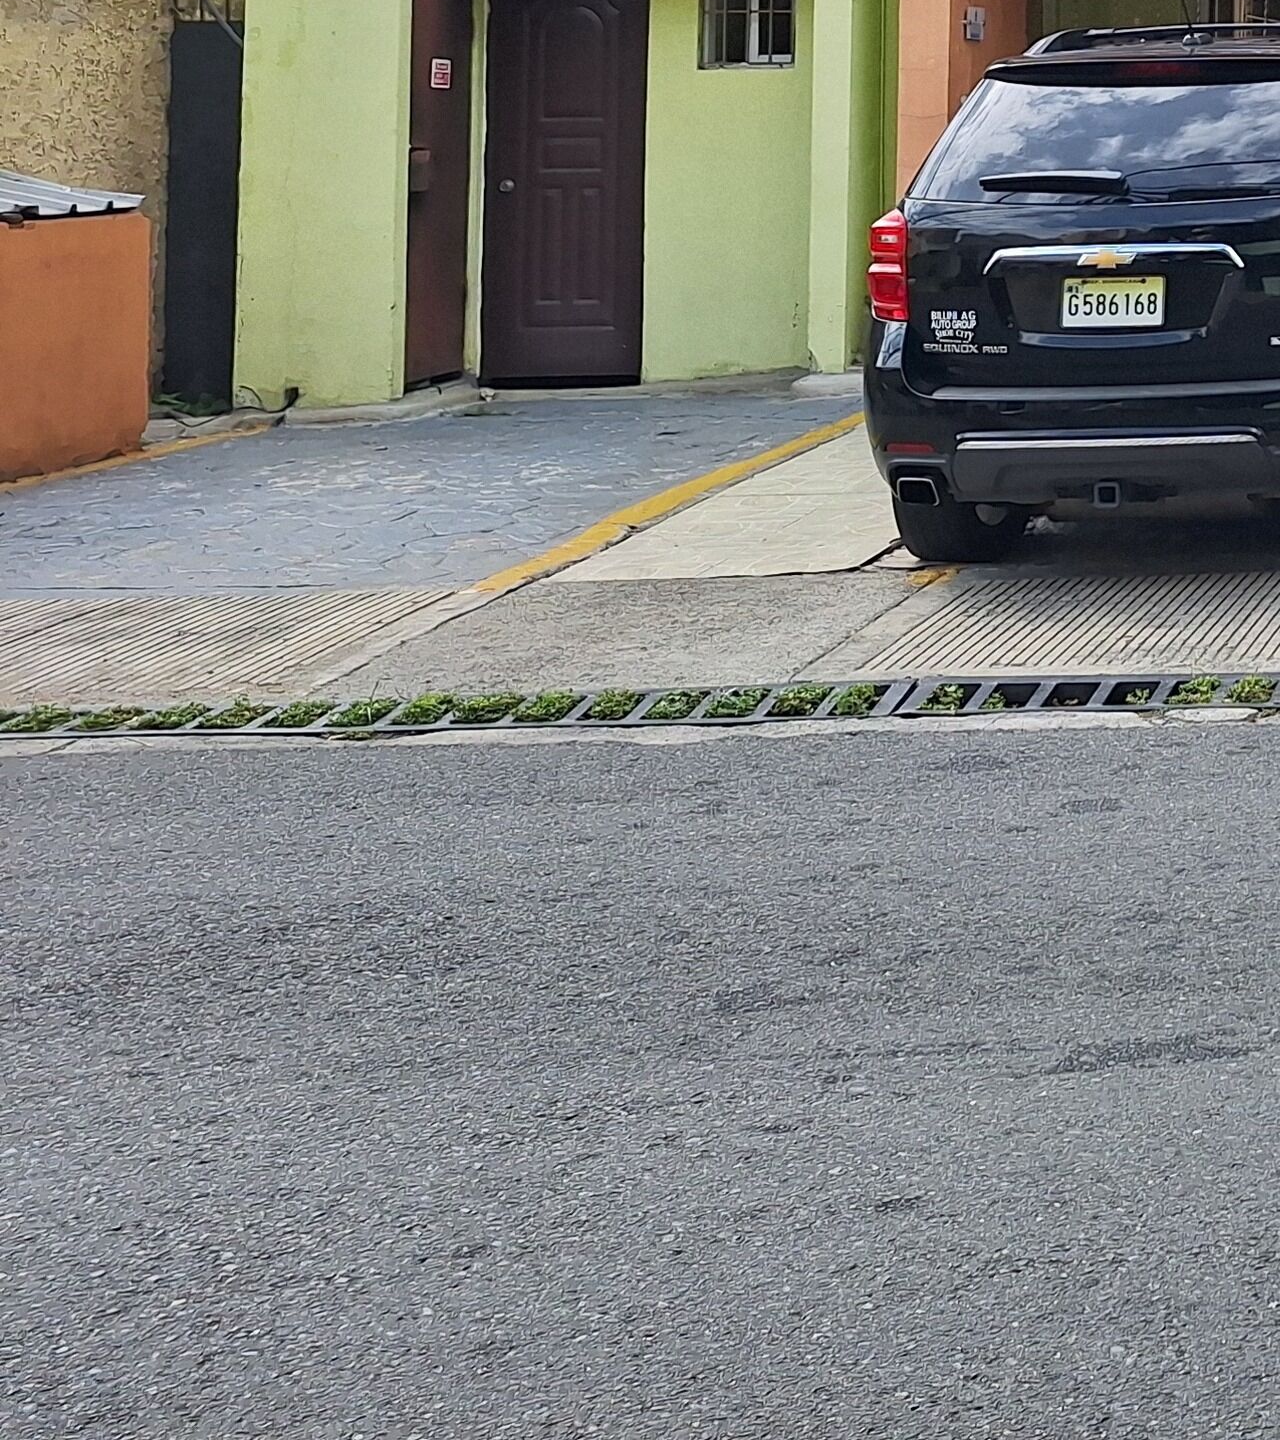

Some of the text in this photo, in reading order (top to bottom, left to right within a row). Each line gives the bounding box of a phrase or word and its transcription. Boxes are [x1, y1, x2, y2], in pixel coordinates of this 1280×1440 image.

[1068, 292, 1158, 317] G586168
[960, 310, 976, 320] AG
[930, 320, 977, 329] AUTO GROUP
[923, 343, 979, 354] EQUINOX
